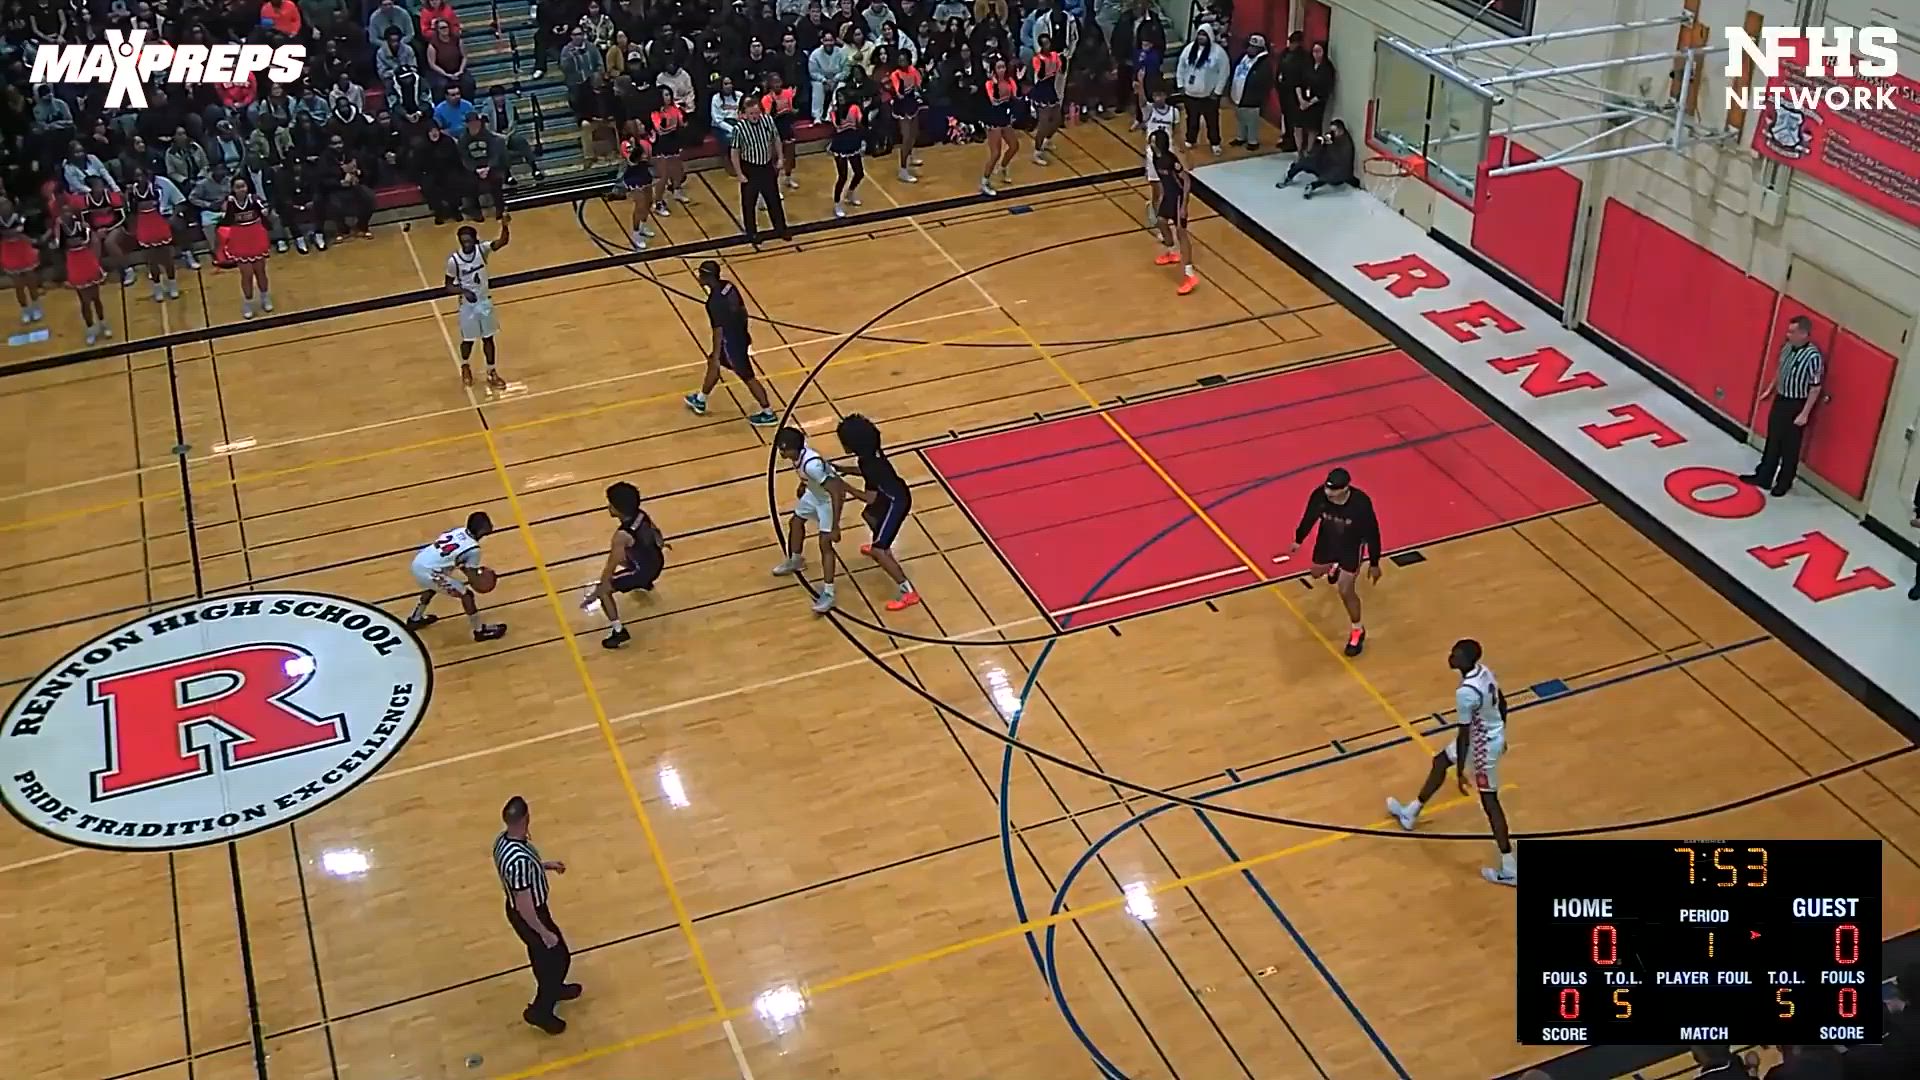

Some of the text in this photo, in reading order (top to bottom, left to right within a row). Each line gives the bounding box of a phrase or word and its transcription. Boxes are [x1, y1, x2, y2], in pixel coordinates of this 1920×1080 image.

[1354, 253, 1896, 602] RENTON
[10, 599, 403, 737] RENTON HIGH SCHOOL
[86, 641, 351, 803] R
[13, 682, 413, 837] PRIDE TRADITION EXCELLENCE
